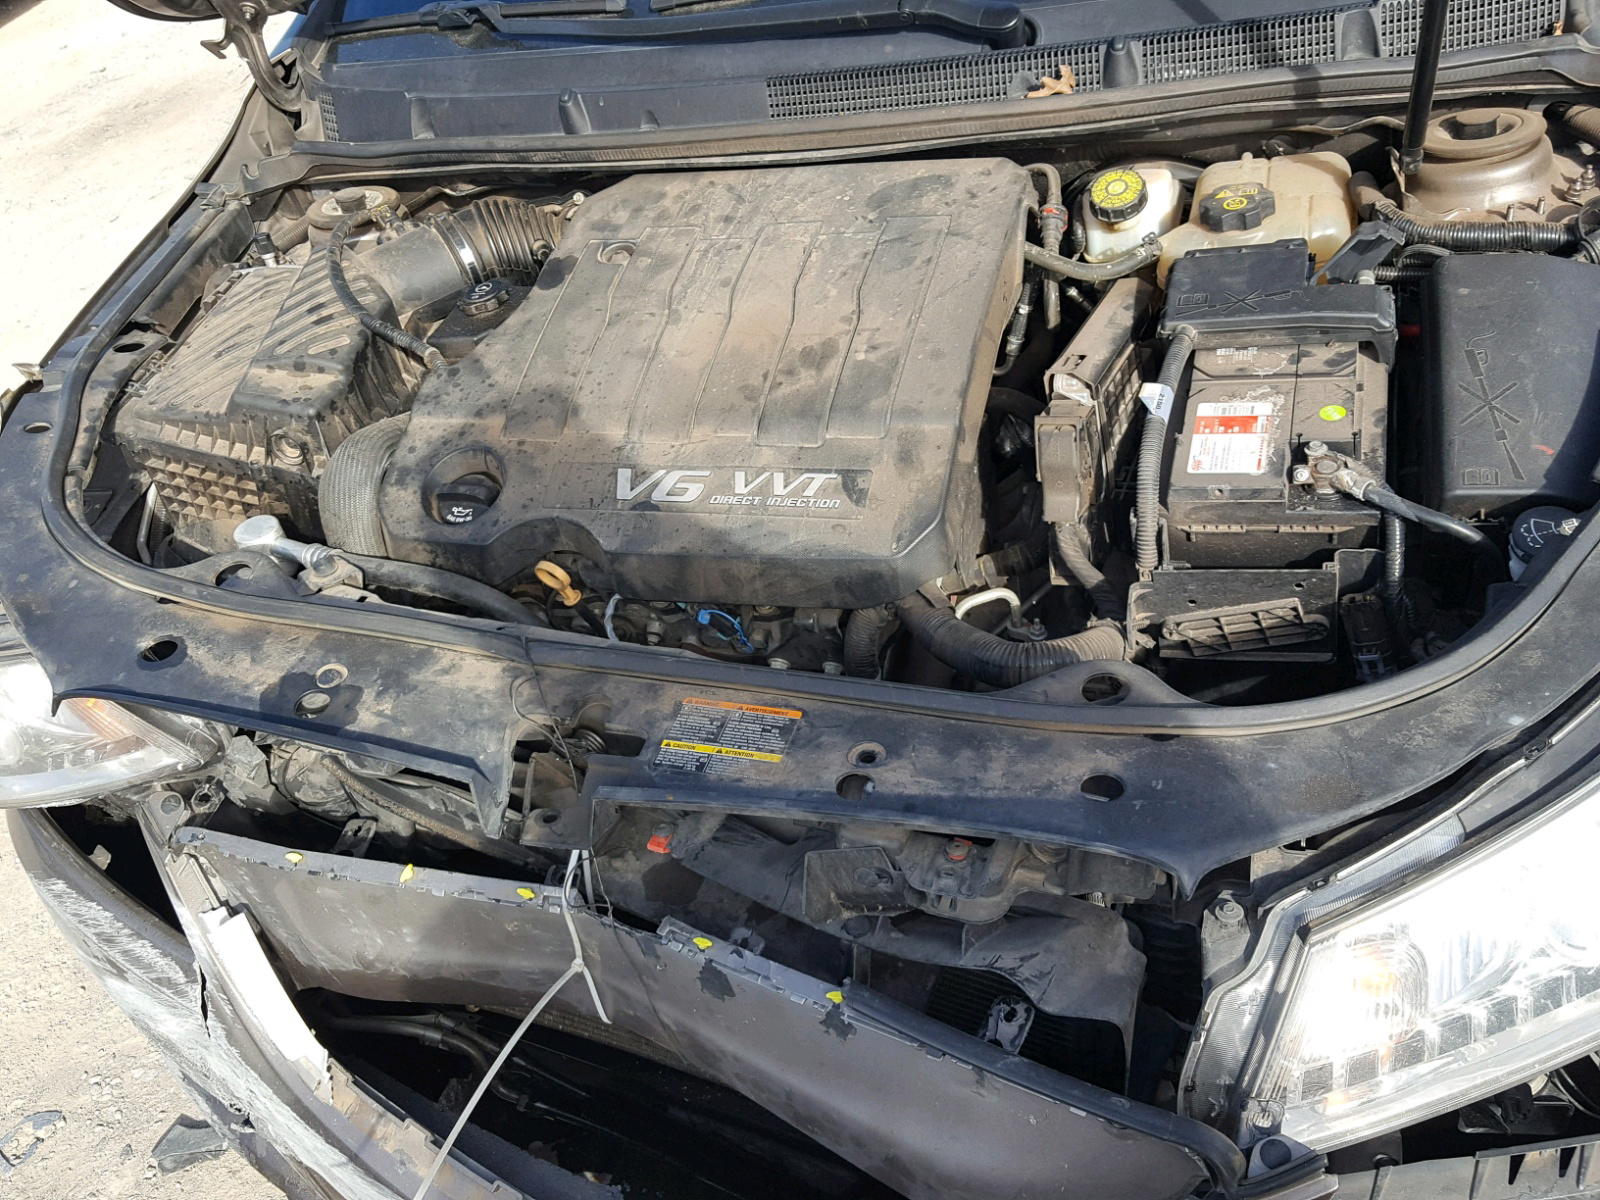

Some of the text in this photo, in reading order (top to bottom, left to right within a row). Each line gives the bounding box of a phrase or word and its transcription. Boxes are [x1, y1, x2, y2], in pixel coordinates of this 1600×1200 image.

[616, 468, 838, 502] V6 VVT
[709, 495, 841, 508] DIRECT INJECTION
[724, 749, 755, 758] ATTENTION
